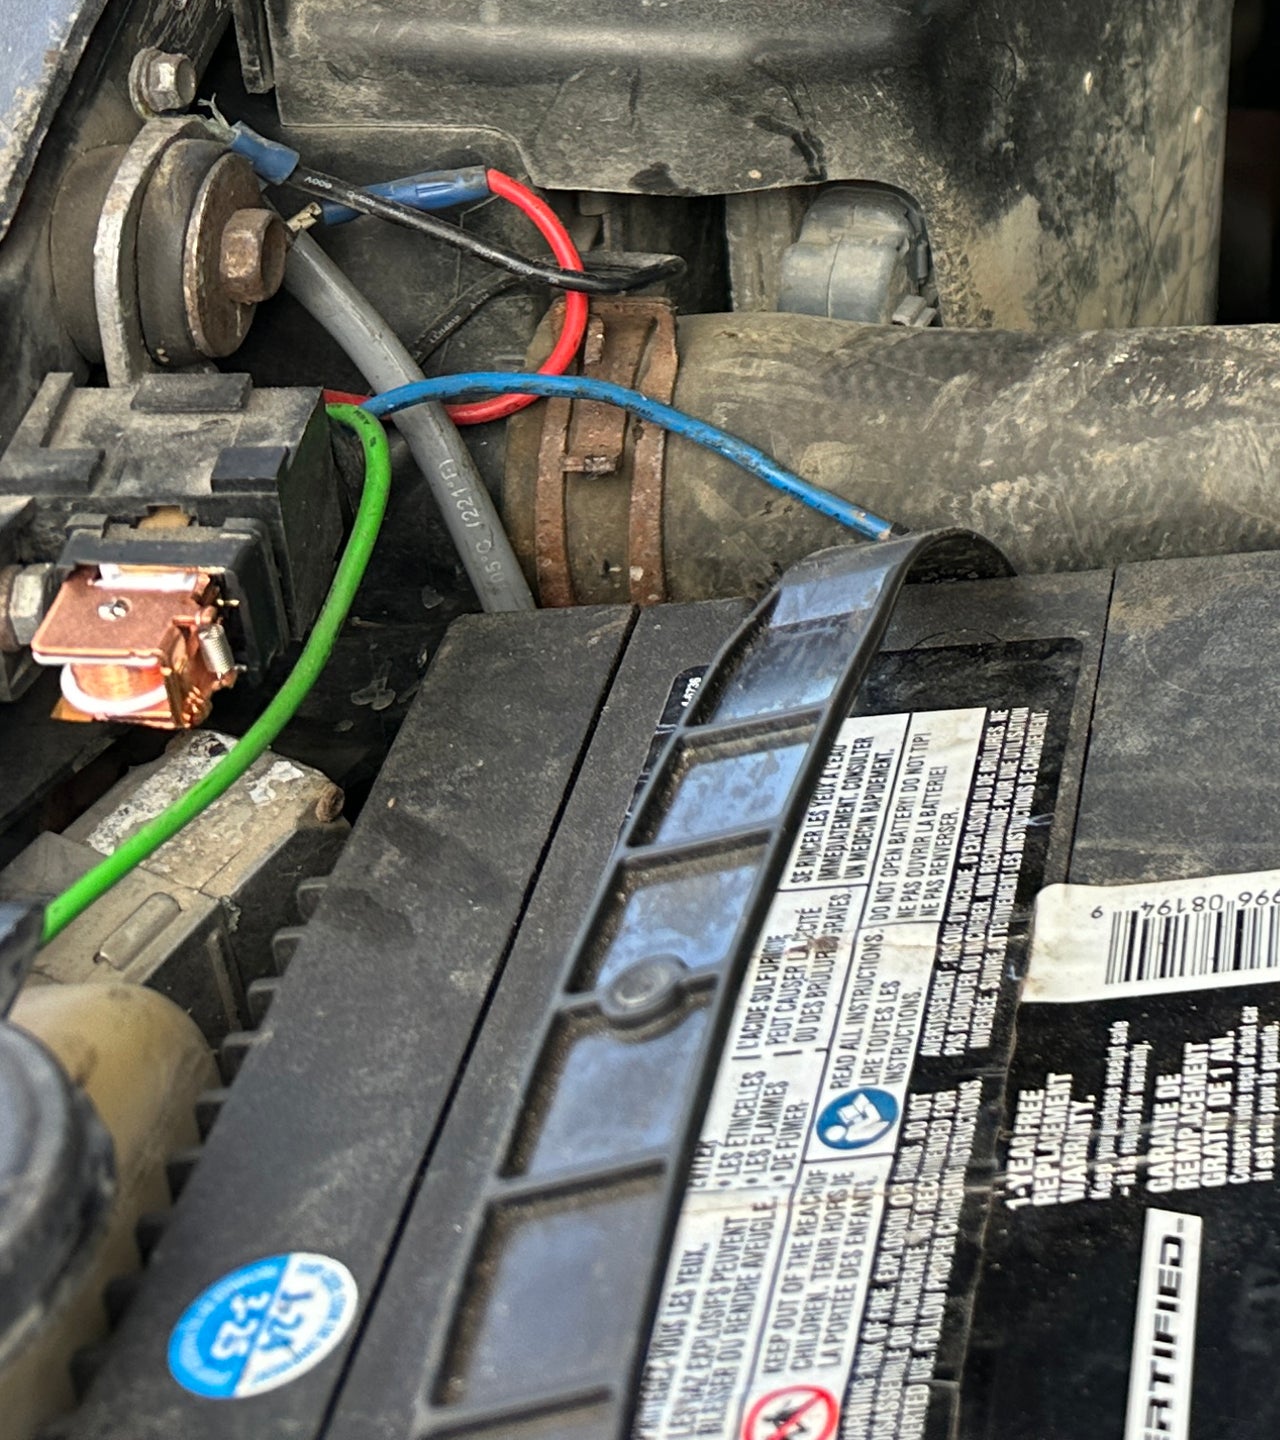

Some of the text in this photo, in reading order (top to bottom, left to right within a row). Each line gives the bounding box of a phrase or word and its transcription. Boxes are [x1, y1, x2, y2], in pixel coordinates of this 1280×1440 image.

[987, 708, 1009, 722] NE
[1001, 706, 1029, 758] UTILISATION
[840, 736, 874, 790] CONSULTER
[903, 753, 926, 775] NOT
[997, 759, 1019, 778] UNE
[899, 777, 921, 792] DO
[971, 786, 993, 800] OU
[974, 772, 996, 786] DE
[991, 779, 1015, 806] POUR
[915, 818, 936, 833] LA
[789, 869, 814, 883] SE
[804, 809, 830, 828] LES
[905, 835, 932, 877] OUVRIR
[842, 863, 867, 879] UN
[879, 847, 905, 877] OPEN
[919, 807, 960, 916] NE PAS RENVERSER.
[873, 880, 897, 903] NOT
[899, 880, 922, 902] PAS
[973, 873, 997, 896] NON
[978, 951, 1006, 989] SUIVRE
[1000, 851, 1024, 870] LES
[1017, 770, 1038, 784] DE
[868, 905, 891, 921] DO
[895, 904, 917, 919] NE
[1089, 905, 1104, 919] 9
[1137, 893, 1225, 917] 08194
[959, 955, 982, 971] OU
[765, 965, 807, 1045] PEUT CAUSER
[828, 928, 886, 1089] READ ALL INSTRUCTIONS.
[1241, 1004, 1259, 1023] car
[793, 1000, 825, 1042] OU DES
[857, 979, 901, 1086] LIRE TOUTES LES
[881, 986, 923, 1084] INSTRUCTIONS.
[942, 1032, 967, 1055] PAS
[1205, 1029, 1236, 1107] DE 1 AN.
[1256, 1071, 1277, 1084] la
[1154, 1072, 1182, 1099] DE
[1256, 1084, 1280, 1112] pour
[715, 1070, 766, 1148] ÉTINCELLES
[750, 1080, 789, 1145] FLAMMES
[1012, 1087, 1045, 1134] FREE
[1089, 1162, 1116, 1199] Keep
[1105, 1019, 1129, 1044] safe
[1121, 1093, 1143, 1111] for
[1169, 1040, 1213, 1190] REMPACEMENT
[1253, 1144, 1275, 1169] est
[1252, 1170, 1274, 1181] il
[852, 1091, 934, 1373] RISK OF EXPLOSION OR DO NOT
[886, 1324, 914, 1346] OR
[930, 1089, 958, 1116] FOR
[760, 1167, 831, 1374] KEEP OUT OF THE REACH OF
[789, 1170, 856, 1370] CHILDREN. TENIR HORS DE
[836, 1249, 863, 1279] DES
[923, 1235, 958, 1290] PROPER
[663, 1240, 711, 1319] LES YEUX.
[817, 1283, 857, 1344] PORTÉE
[912, 1291, 948, 1348] FOLLOW
[1144, 1234, 1186, 1440] RTIFIED
[818, 1343, 845, 1367] LA
